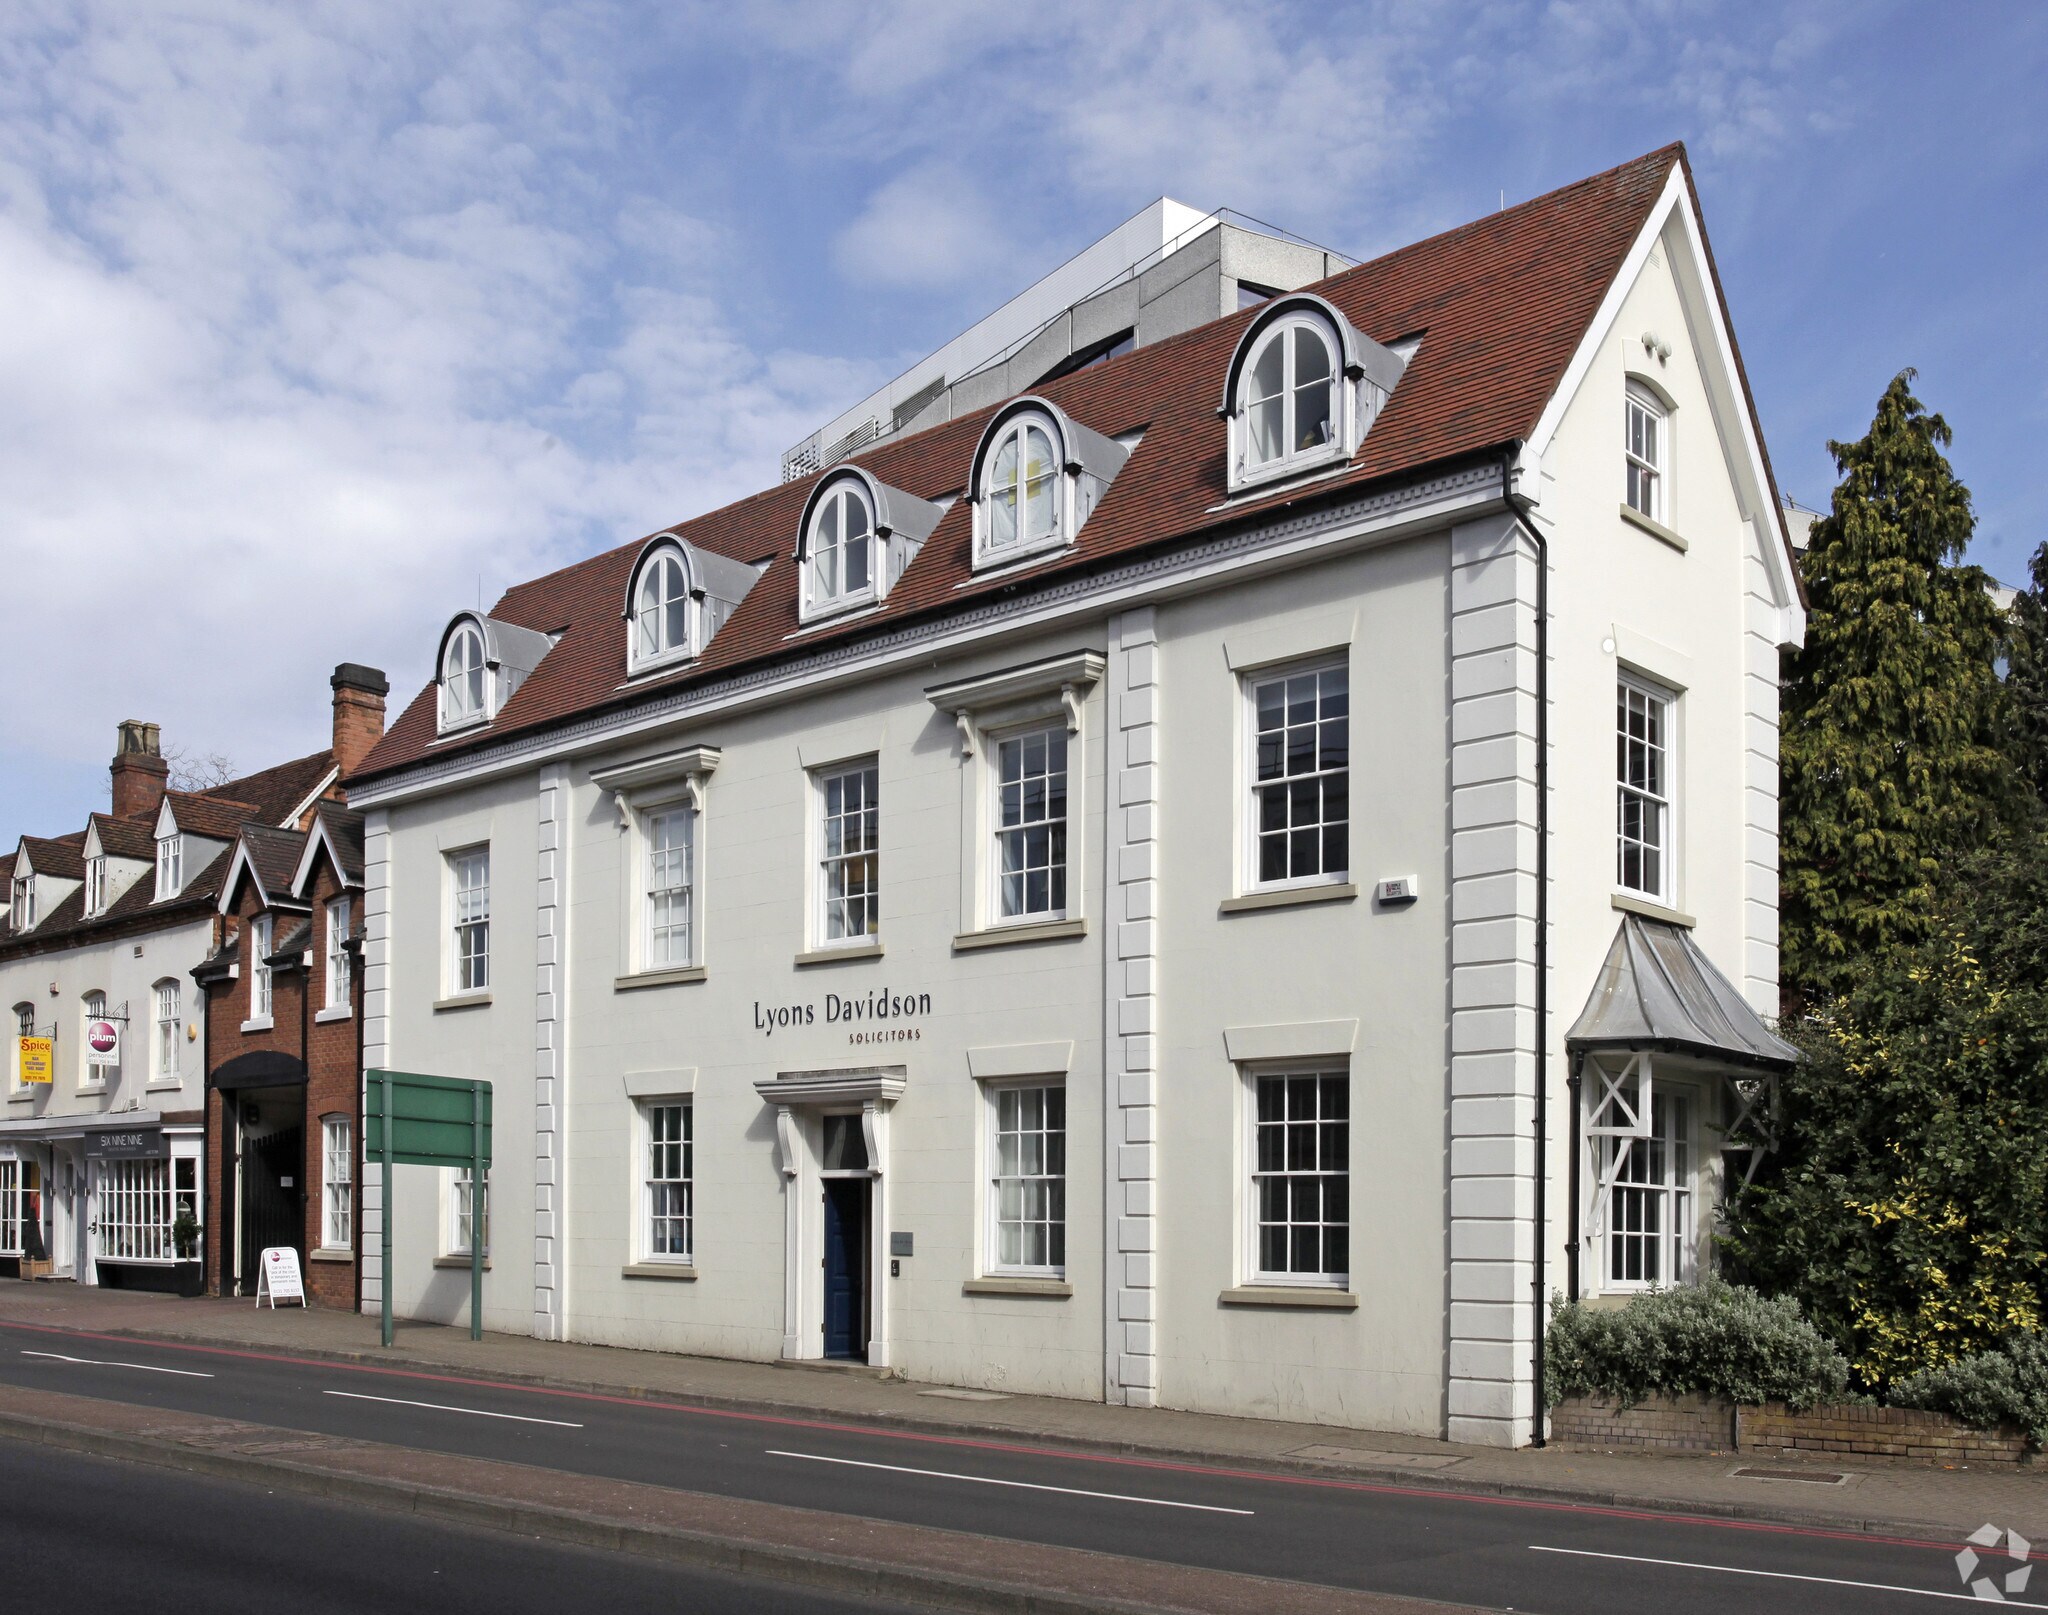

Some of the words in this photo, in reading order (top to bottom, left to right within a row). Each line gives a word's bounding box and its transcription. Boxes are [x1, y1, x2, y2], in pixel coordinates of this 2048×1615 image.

[754, 1001, 814, 1037] Lyons
[825, 987, 931, 1023] Davidson
[90, 1032, 116, 1043] plum
[849, 1028, 921, 1045] SOLICITORS
[21, 1038, 50, 1052] Spice
[101, 1136, 111, 1147] SIX
[111, 1135, 127, 1146] NINE
[127, 1134, 143, 1146] NINE
